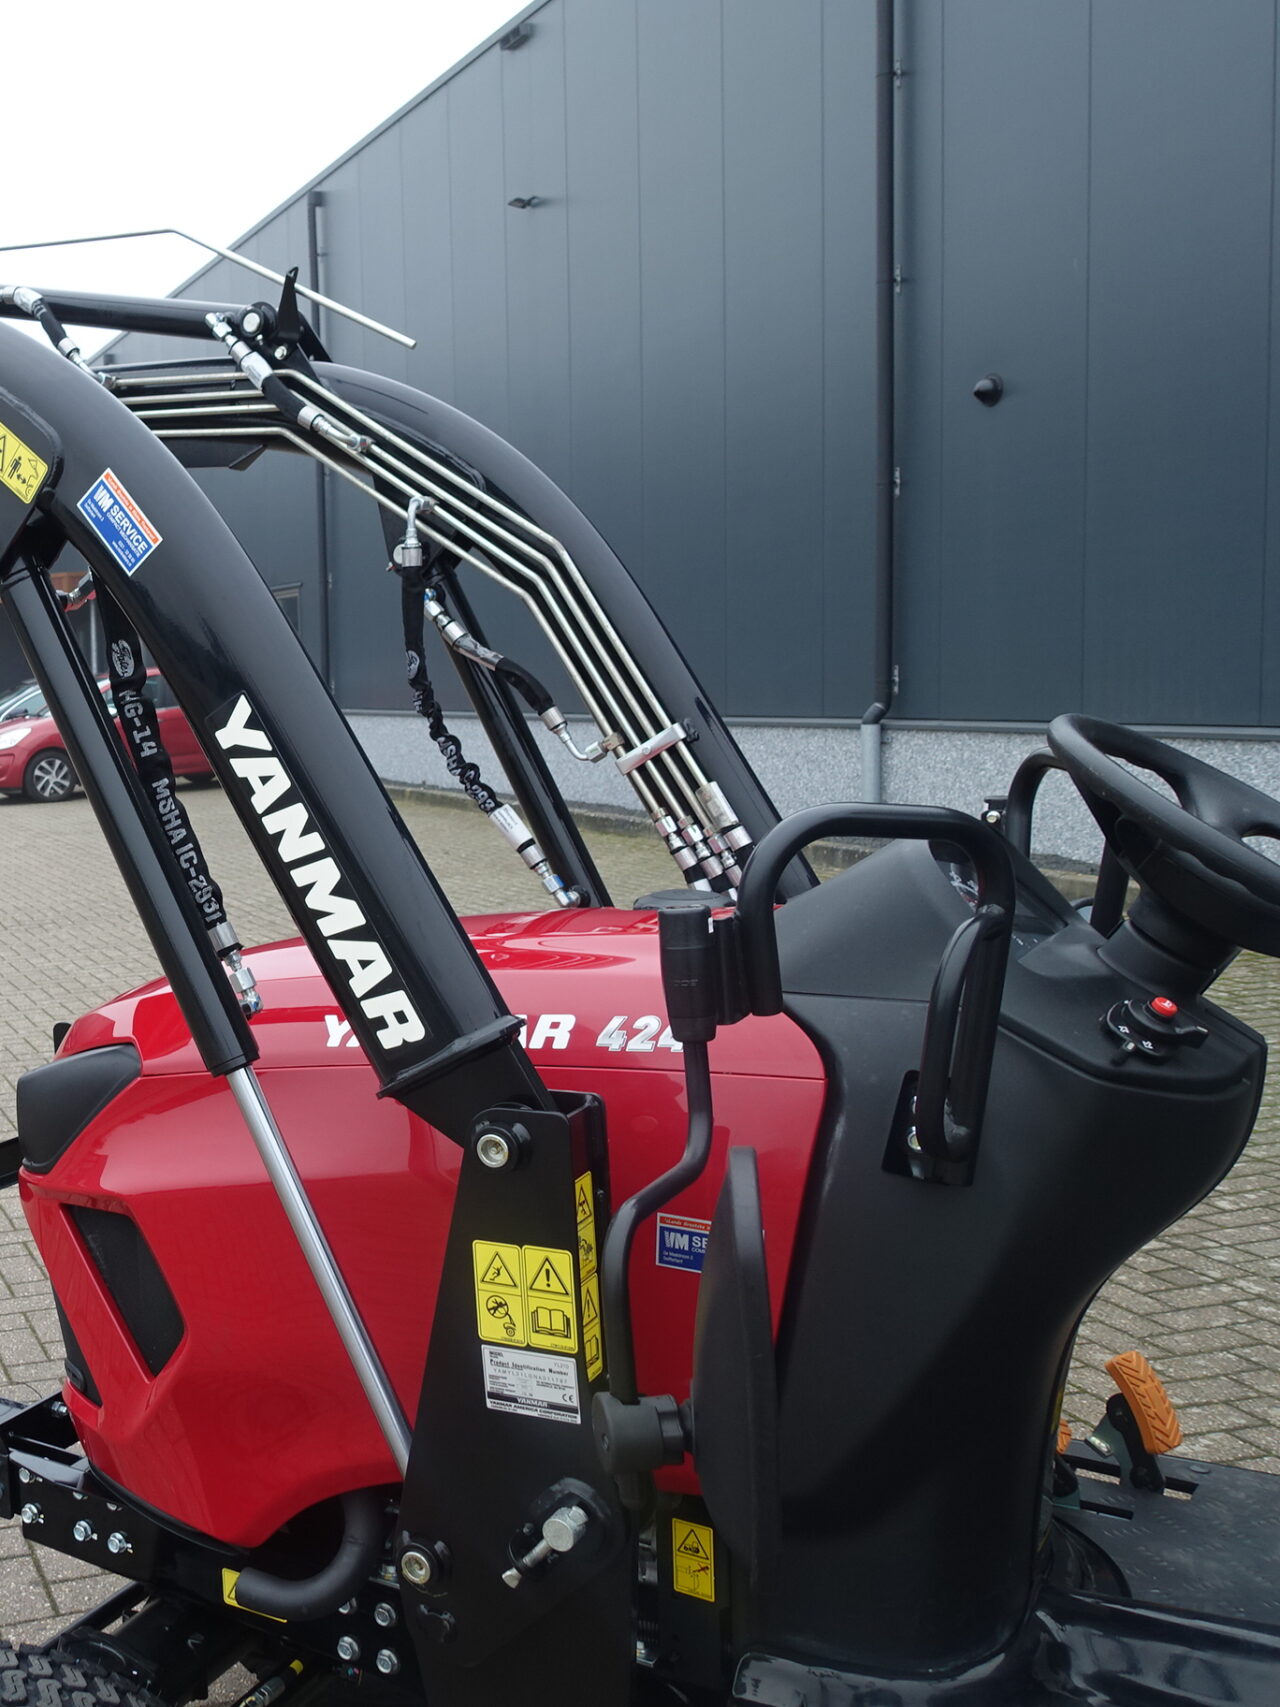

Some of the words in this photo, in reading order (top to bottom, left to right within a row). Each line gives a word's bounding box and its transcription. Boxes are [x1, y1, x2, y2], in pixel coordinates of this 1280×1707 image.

[93, 484, 114, 513] VM
[110, 504, 148, 554] SERVICE
[151, 777, 187, 845] MSHA
[215, 694, 426, 1050] YANMAR
[664, 1230, 689, 1251] VM
[548, 1367, 569, 1376] Number
[489, 1400, 512, 1408] YANMAR
[513, 1404, 538, 1412] AMERICA
[539, 1408, 578, 1419] CORPORATION
[517, 1397, 548, 1408] YANMAR
